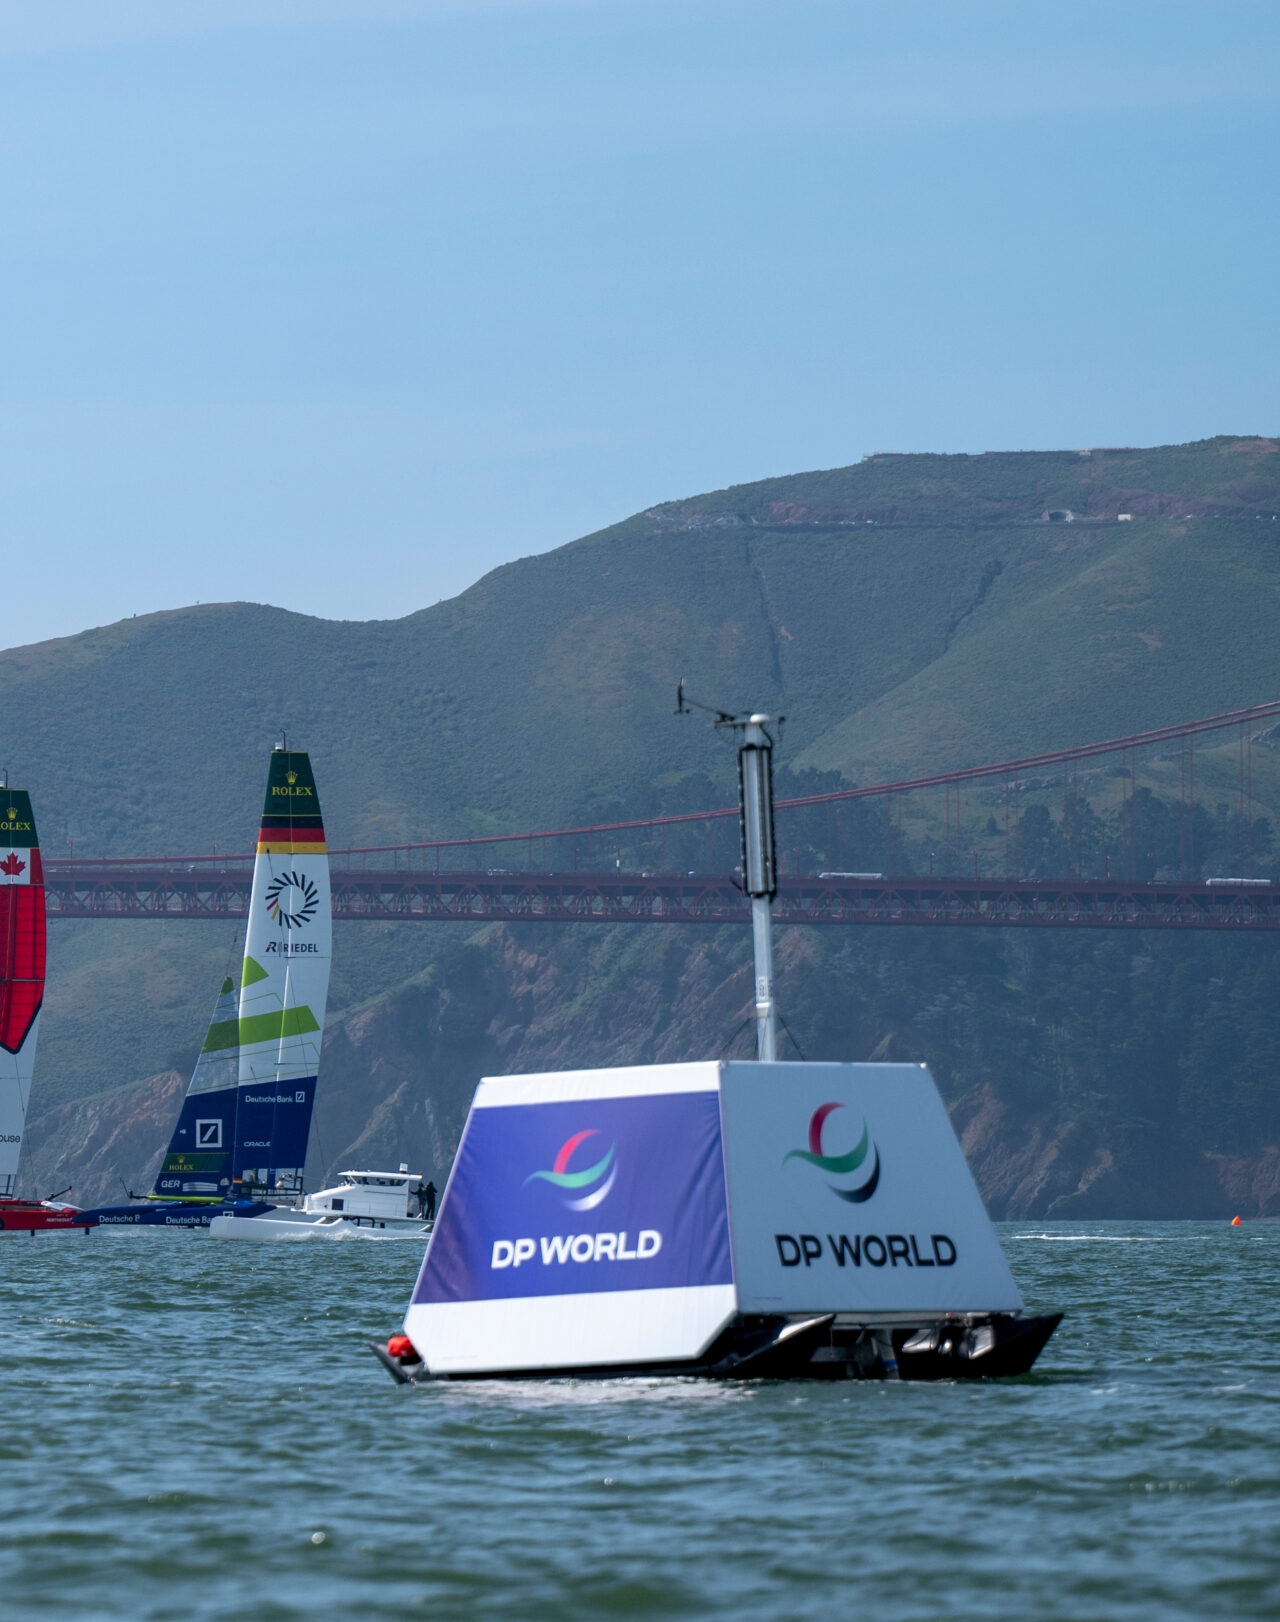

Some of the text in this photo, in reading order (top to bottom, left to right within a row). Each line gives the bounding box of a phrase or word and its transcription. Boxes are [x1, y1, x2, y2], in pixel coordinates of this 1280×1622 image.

[271, 786, 313, 796] ROLEX
[283, 943, 319, 953] RIEDEL
[245, 1095, 293, 1103] Deutsche Bank
[161, 1180, 181, 1188] GER
[99, 1215, 134, 1223] Deutsche
[165, 1216, 200, 1224] Deutsche
[491, 1230, 663, 1269] DP WORLD
[774, 1234, 958, 1267] DP WORLD
